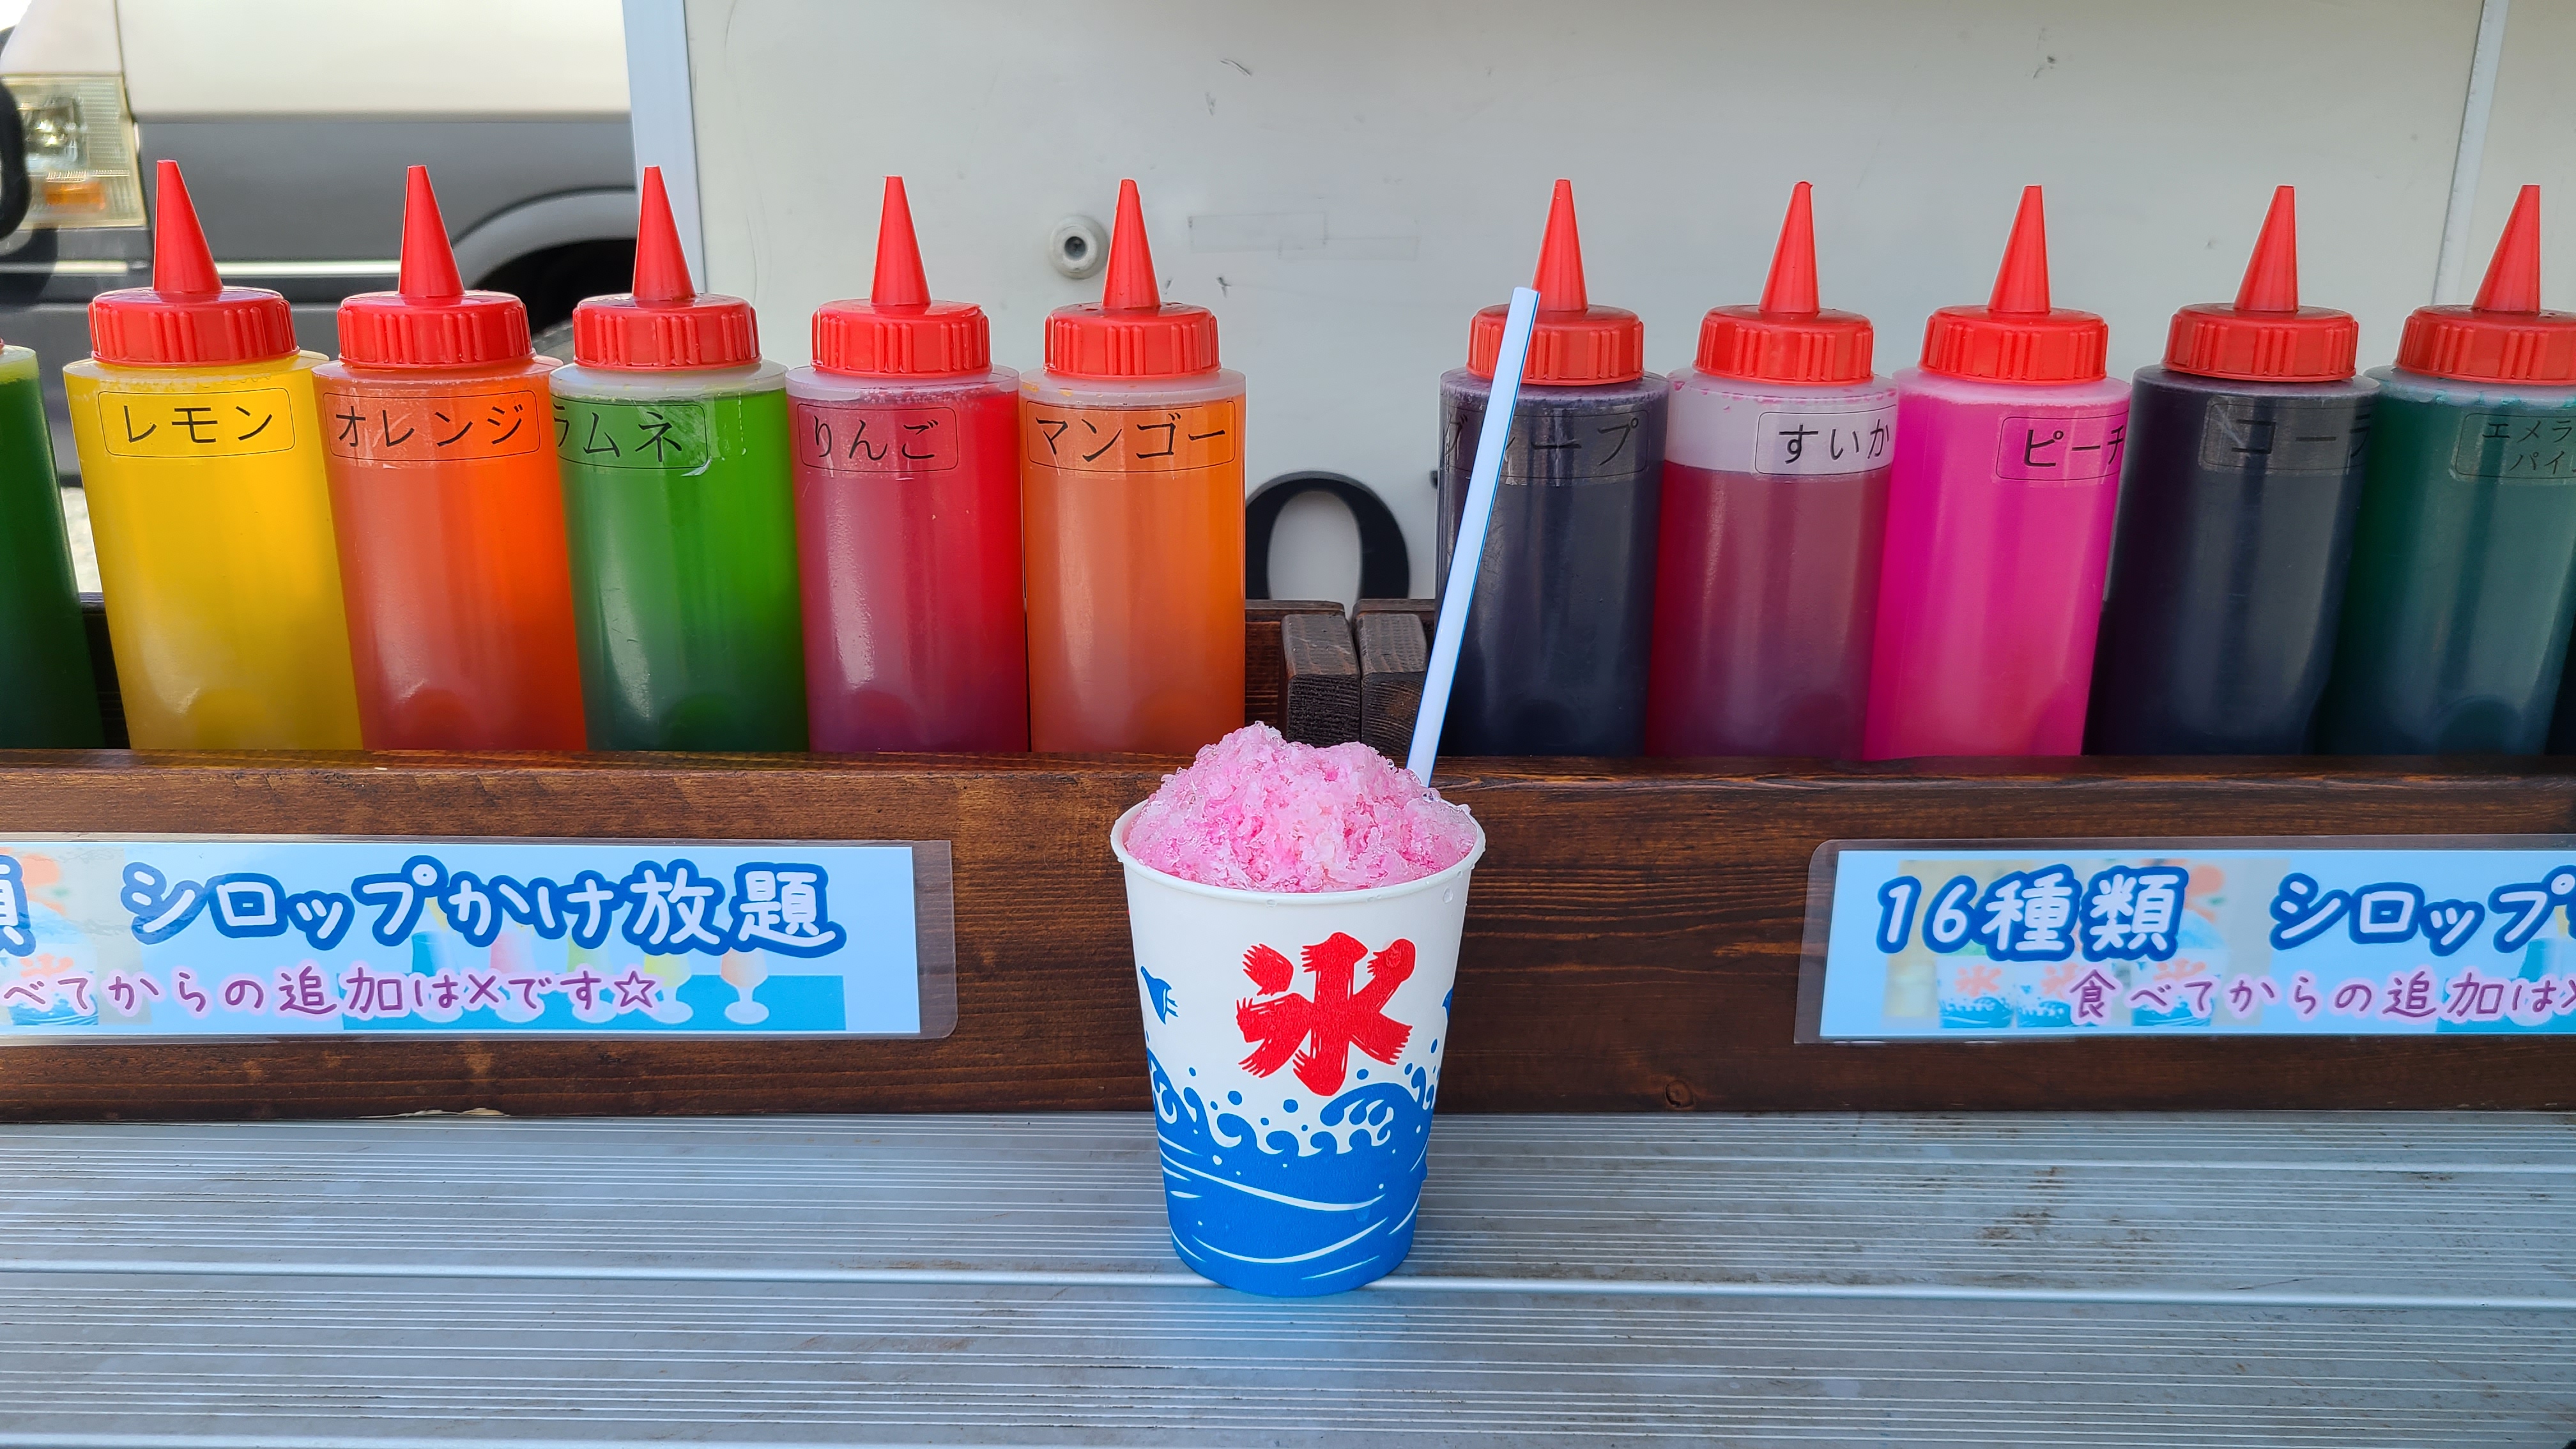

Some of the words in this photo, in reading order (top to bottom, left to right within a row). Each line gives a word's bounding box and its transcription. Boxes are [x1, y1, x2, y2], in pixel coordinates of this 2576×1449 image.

[121, 404, 273, 443] レモン
[335, 402, 524, 448] オレンジ
[811, 417, 938, 461] りんご
[1035, 411, 1227, 462] マンゴー
[1445, 414, 1639, 466] グープ
[1778, 418, 1890, 464] すいか
[2024, 424, 2125, 467] ピーチ
[2231, 413, 2372, 458] コーラ
[2482, 420, 2576, 443] エメラ
[2509, 450, 2576, 475] パイ
[121, 855, 847, 958] シロップかけ放題
[1876, 863, 2188, 961] 16種類
[1236, 931, 1416, 1096] 氷
